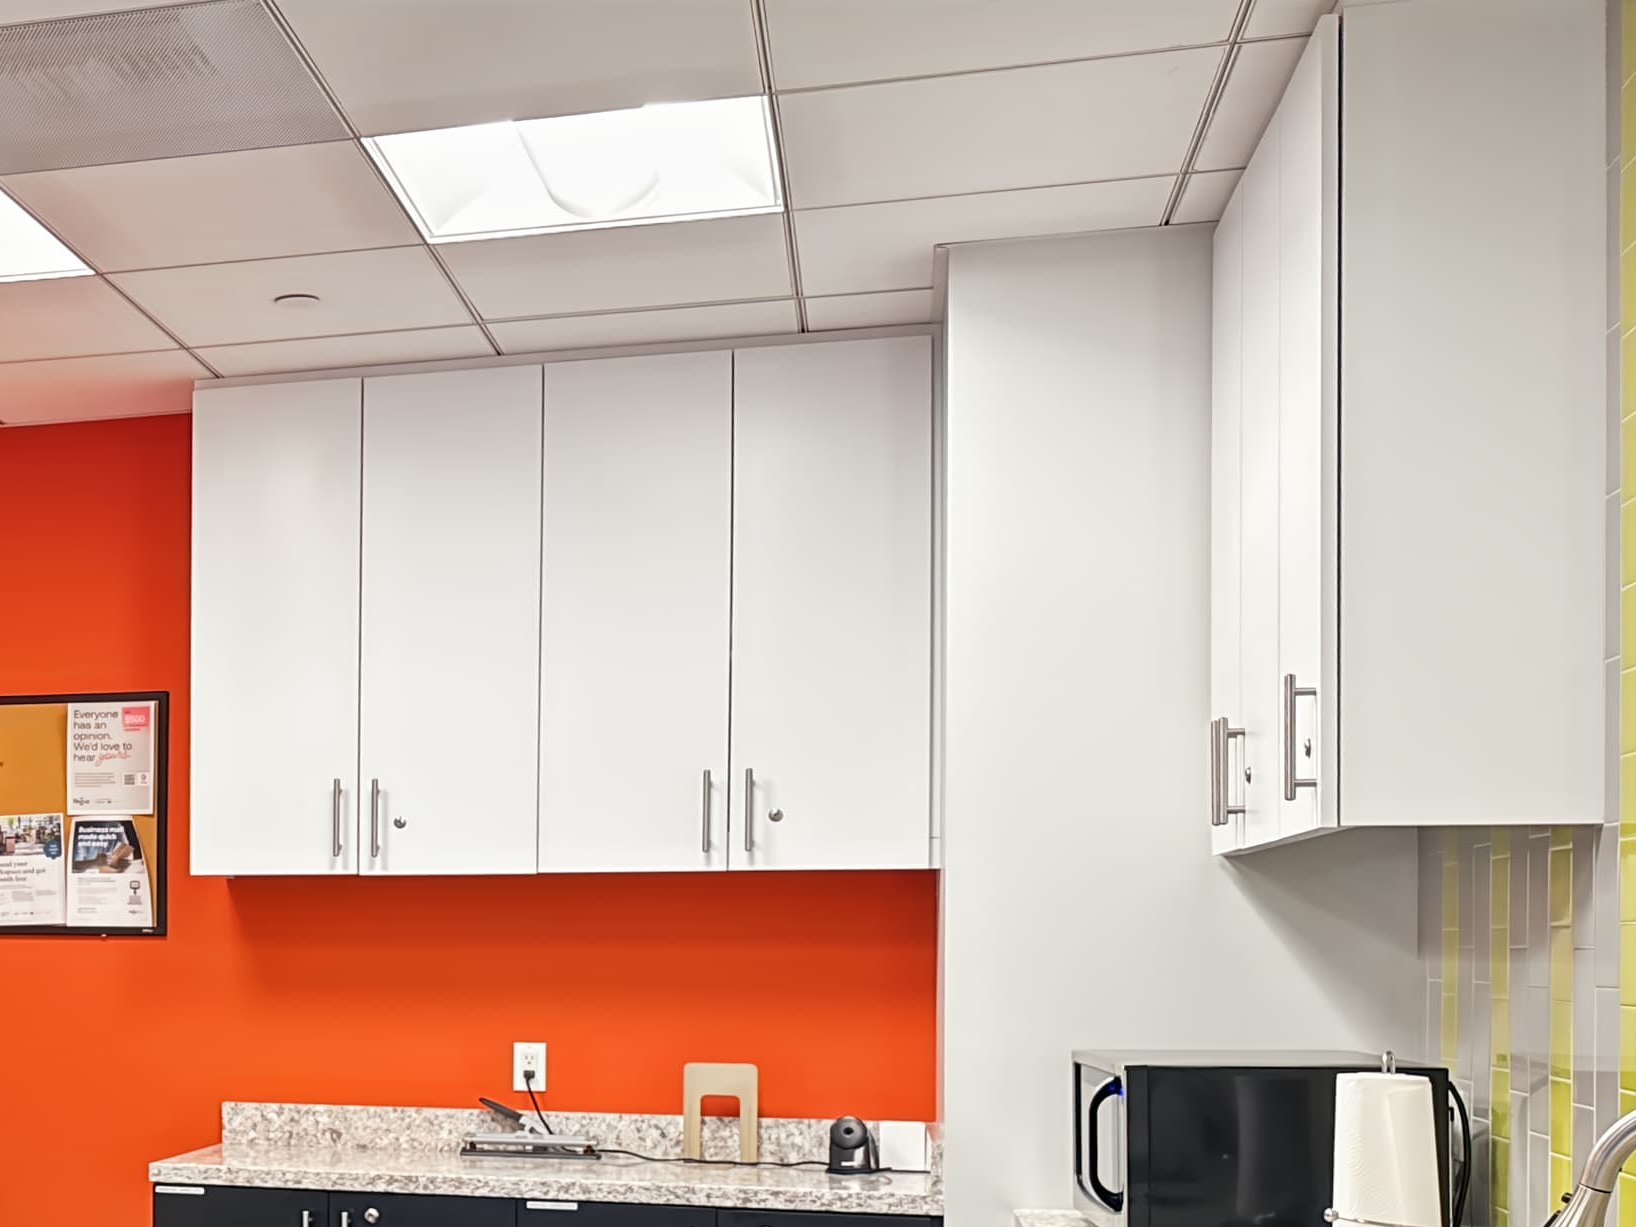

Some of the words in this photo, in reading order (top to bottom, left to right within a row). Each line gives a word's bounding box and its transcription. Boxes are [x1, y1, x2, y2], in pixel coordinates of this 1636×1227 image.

[73, 709, 119, 720] Everyone
[73, 721, 92, 729] has
[73, 732, 112, 741] opinion.
[73, 742, 98, 751] We'd
[100, 742, 120, 751] love
[123, 742, 133, 751] to
[73, 753, 95, 762] hear
